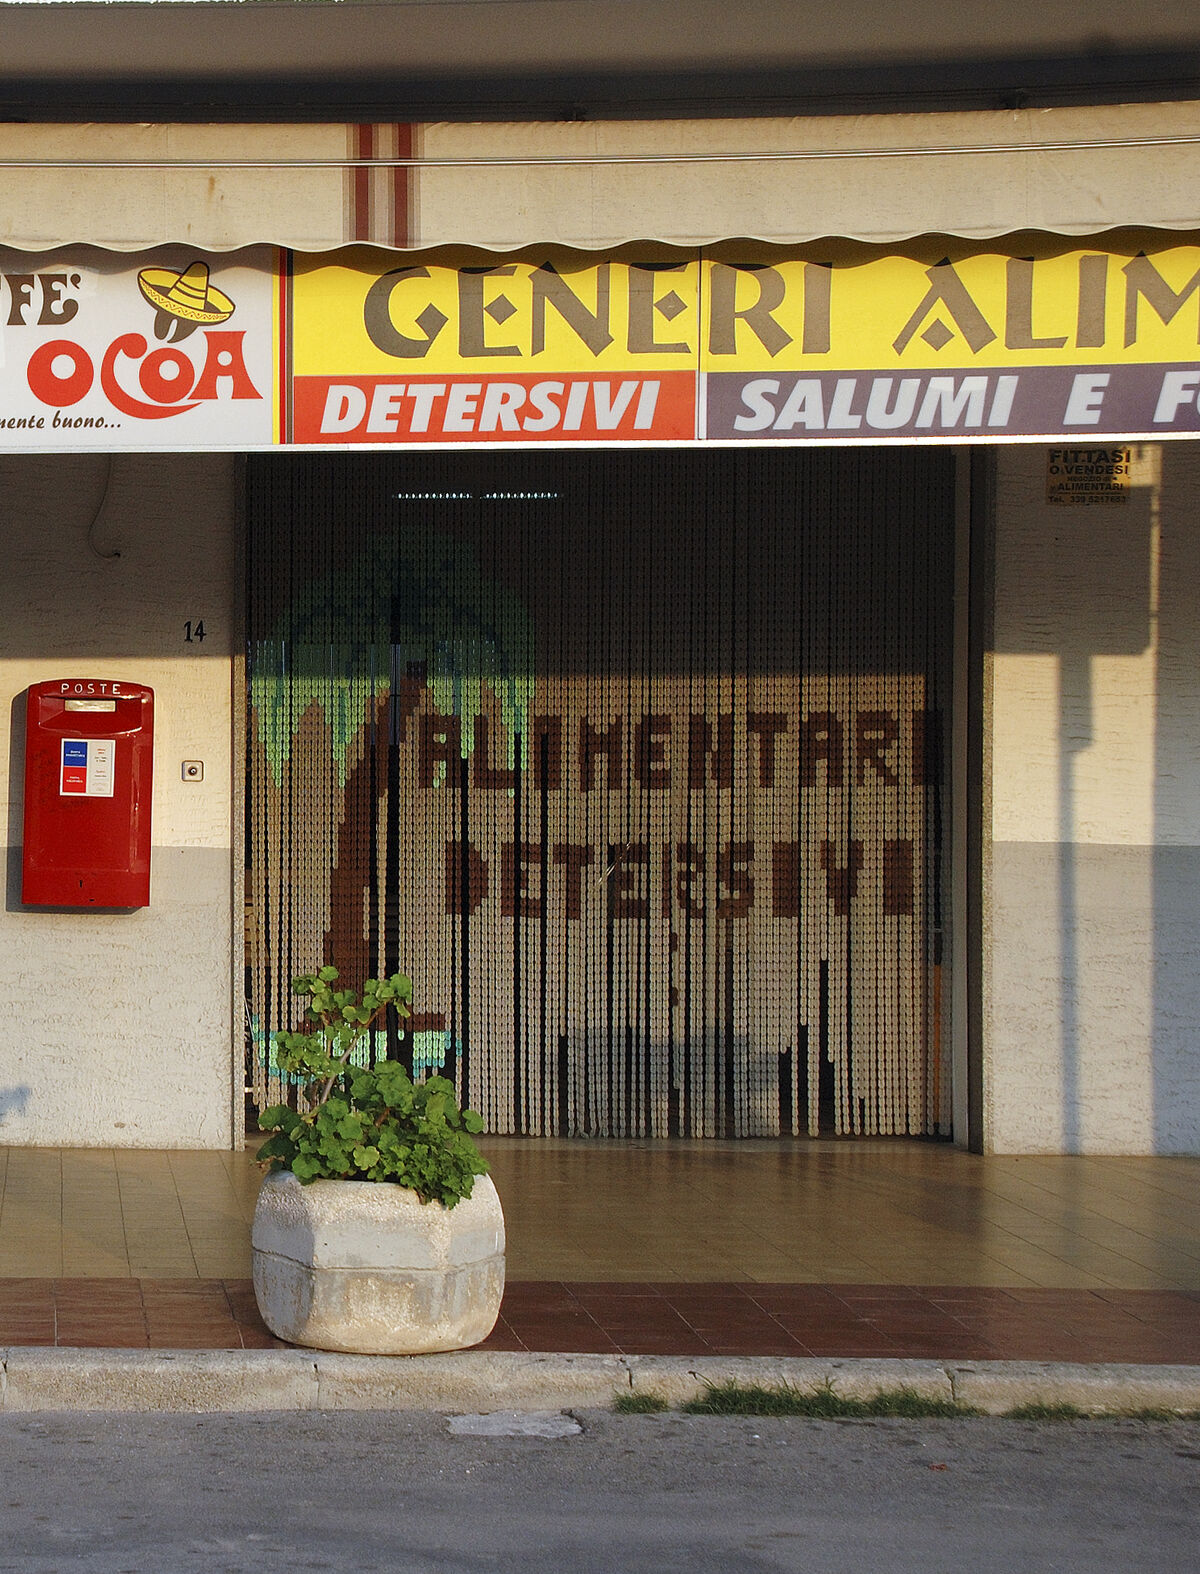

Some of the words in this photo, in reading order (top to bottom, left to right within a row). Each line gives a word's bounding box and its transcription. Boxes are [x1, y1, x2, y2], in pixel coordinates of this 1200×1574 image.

[363, 260, 833, 358] GENERI
[891, 250, 1200, 355] ALIM
[52, 409, 122, 430] buono...
[319, 380, 662, 434] DETERSIVI
[733, 374, 1019, 432] SALUMI
[1062, 373, 1111, 425] E
[1152, 370, 1200, 423] F
[183, 620, 207, 643] 14
[60, 683, 121, 695] POSTE
